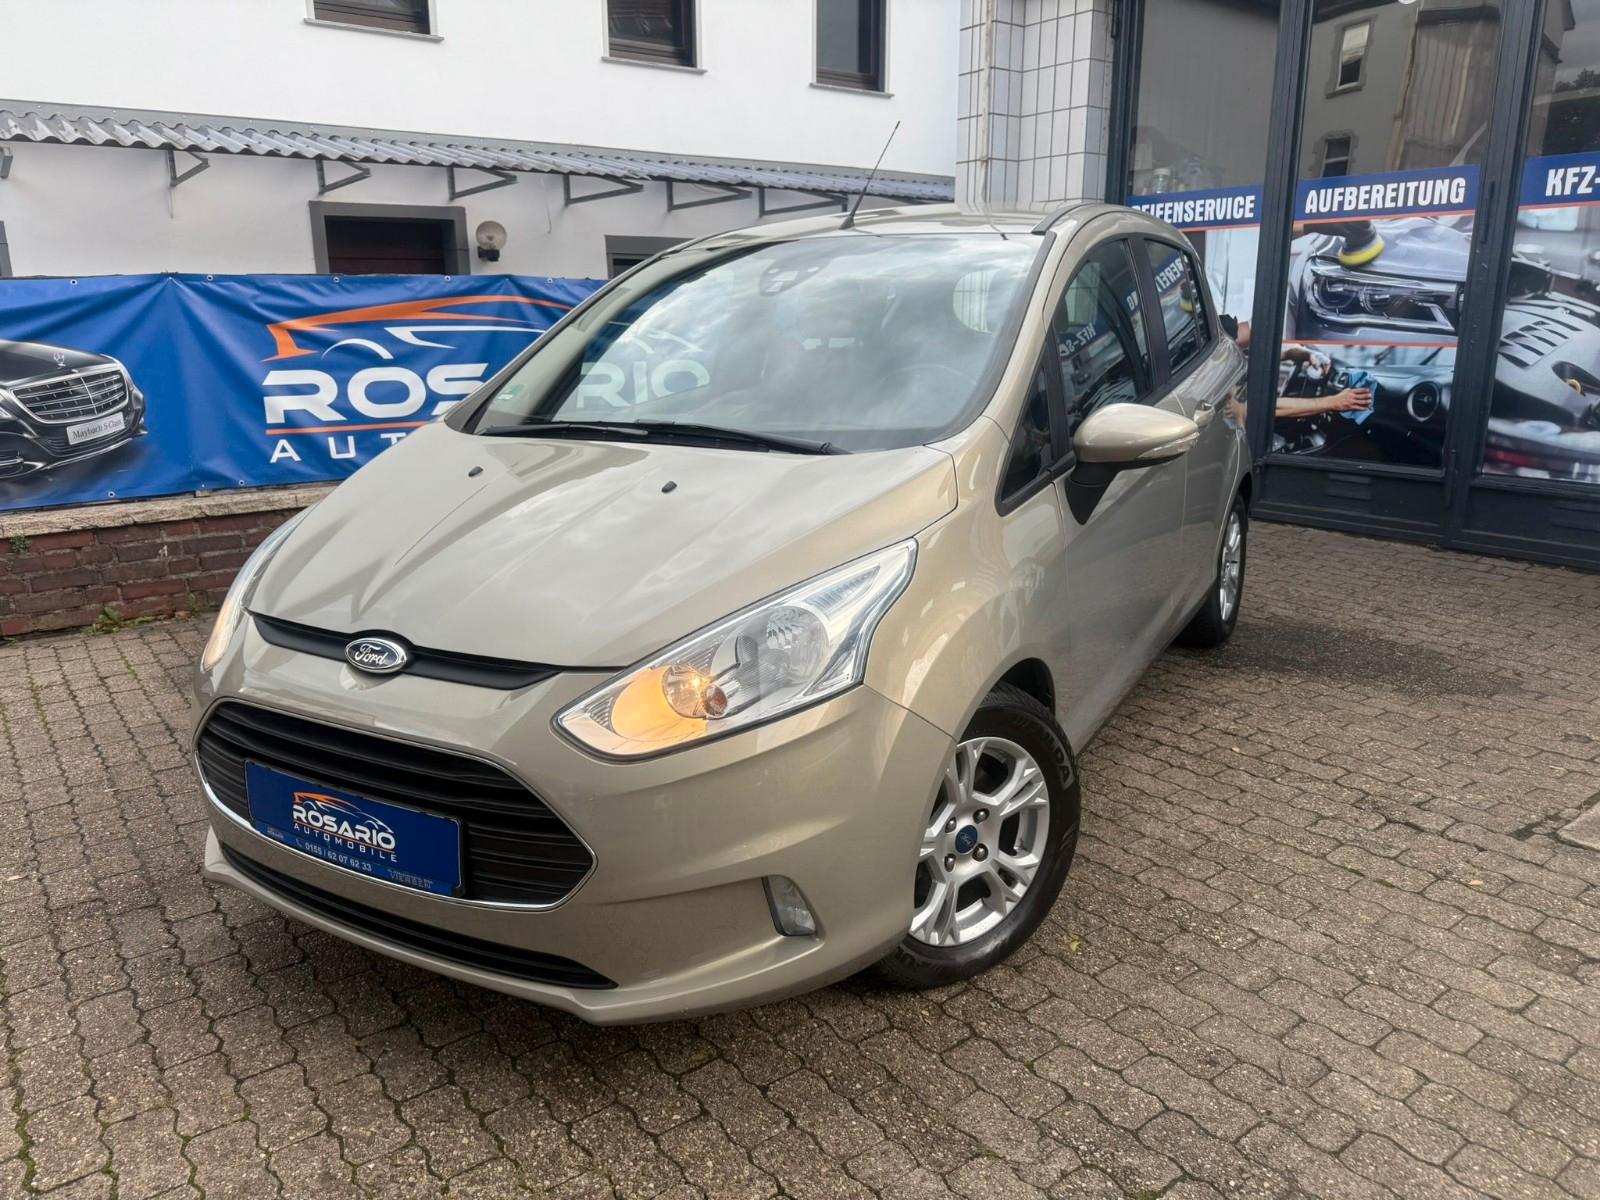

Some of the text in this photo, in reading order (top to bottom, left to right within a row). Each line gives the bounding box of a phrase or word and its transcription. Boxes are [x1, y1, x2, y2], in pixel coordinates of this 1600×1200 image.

[1304, 177, 1467, 214] AUFBEREITUNG
[1545, 165, 1600, 197] KFZ-
[354, 643, 389, 665] Ford
[292, 804, 396, 850] ROSARIO
[293, 822, 398, 863] AUTOMOBILE
